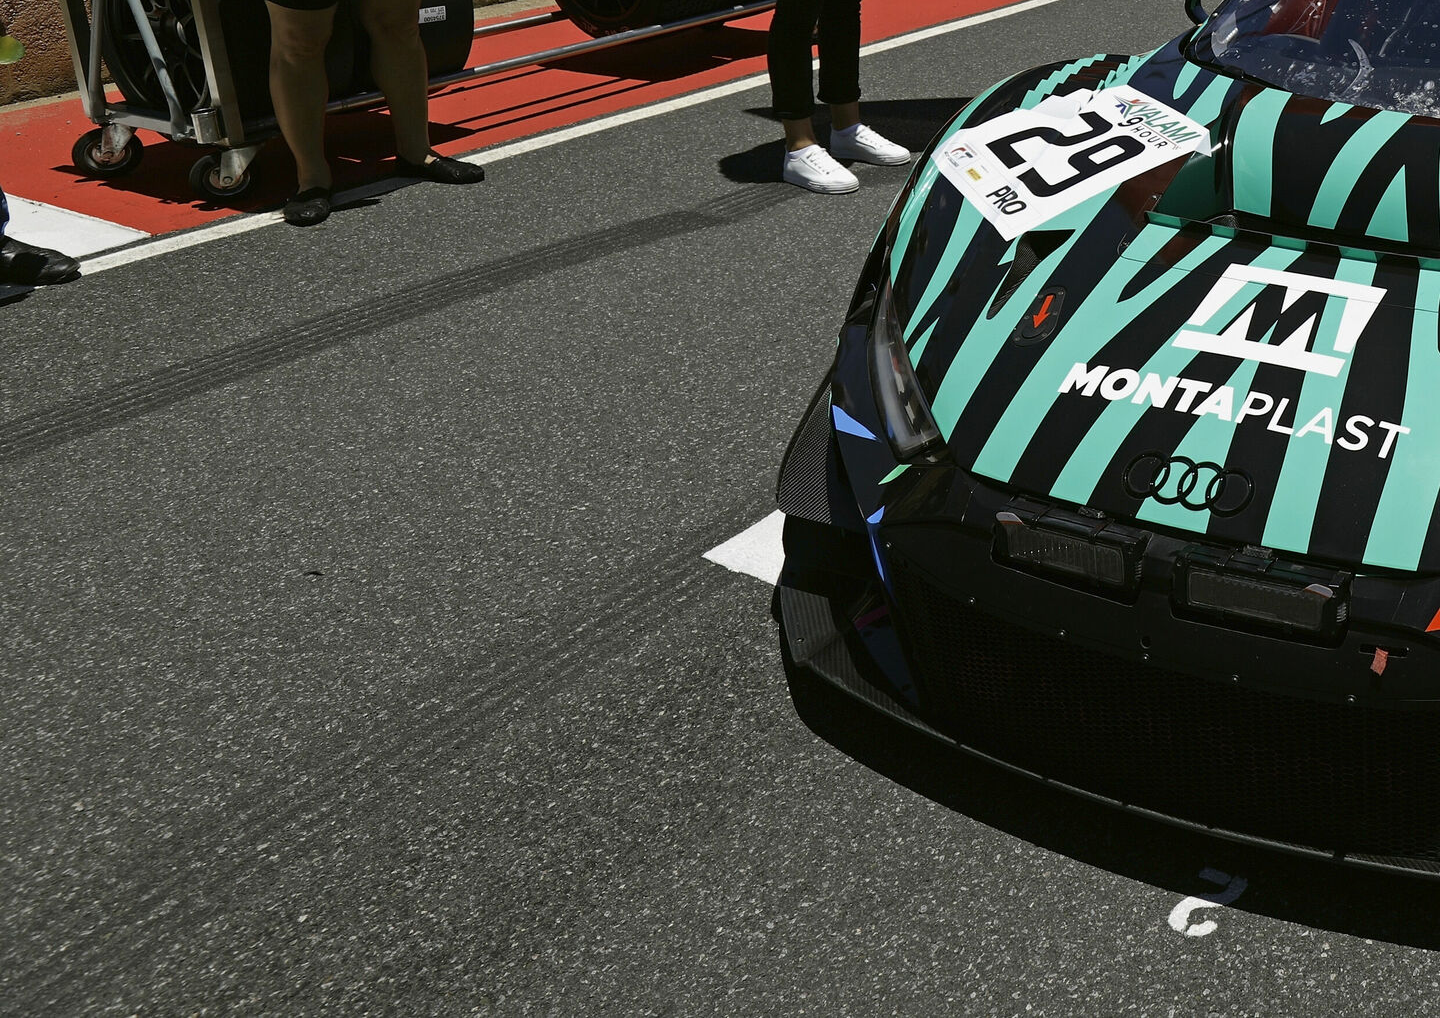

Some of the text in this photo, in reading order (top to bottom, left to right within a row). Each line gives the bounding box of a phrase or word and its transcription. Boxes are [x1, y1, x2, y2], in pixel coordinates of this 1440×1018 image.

[1113, 95, 1201, 143] KYALAMI
[1117, 116, 1168, 150] 9 HOUR
[985, 111, 1146, 198] 29
[985, 185, 1027, 215] PRO
[1057, 362, 1411, 459] MONTAPLAST
